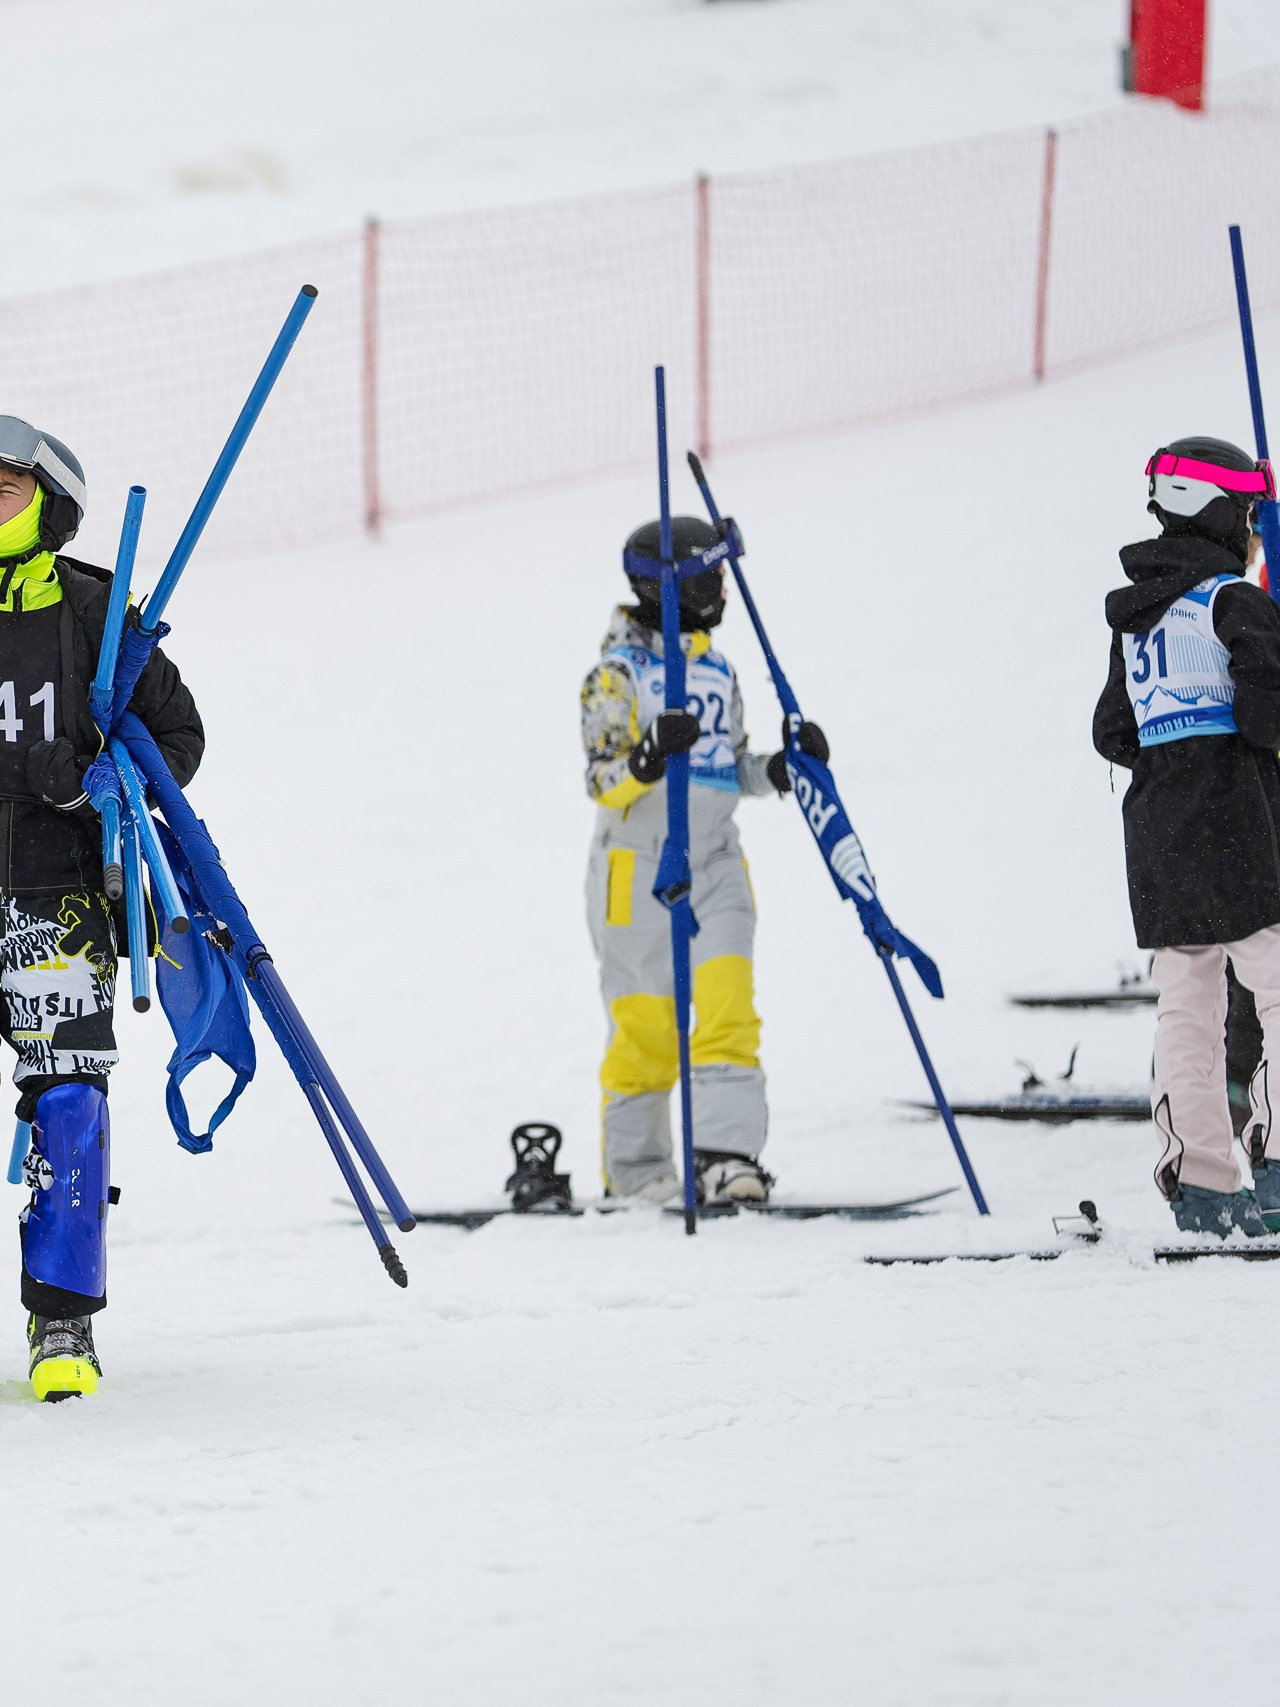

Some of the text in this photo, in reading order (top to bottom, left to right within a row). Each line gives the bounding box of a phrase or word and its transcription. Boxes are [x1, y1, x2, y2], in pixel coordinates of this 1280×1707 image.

[1132, 628, 1168, 684] 31
[684, 693, 729, 737] 22
[10, 1013, 38, 1029] RIDE
